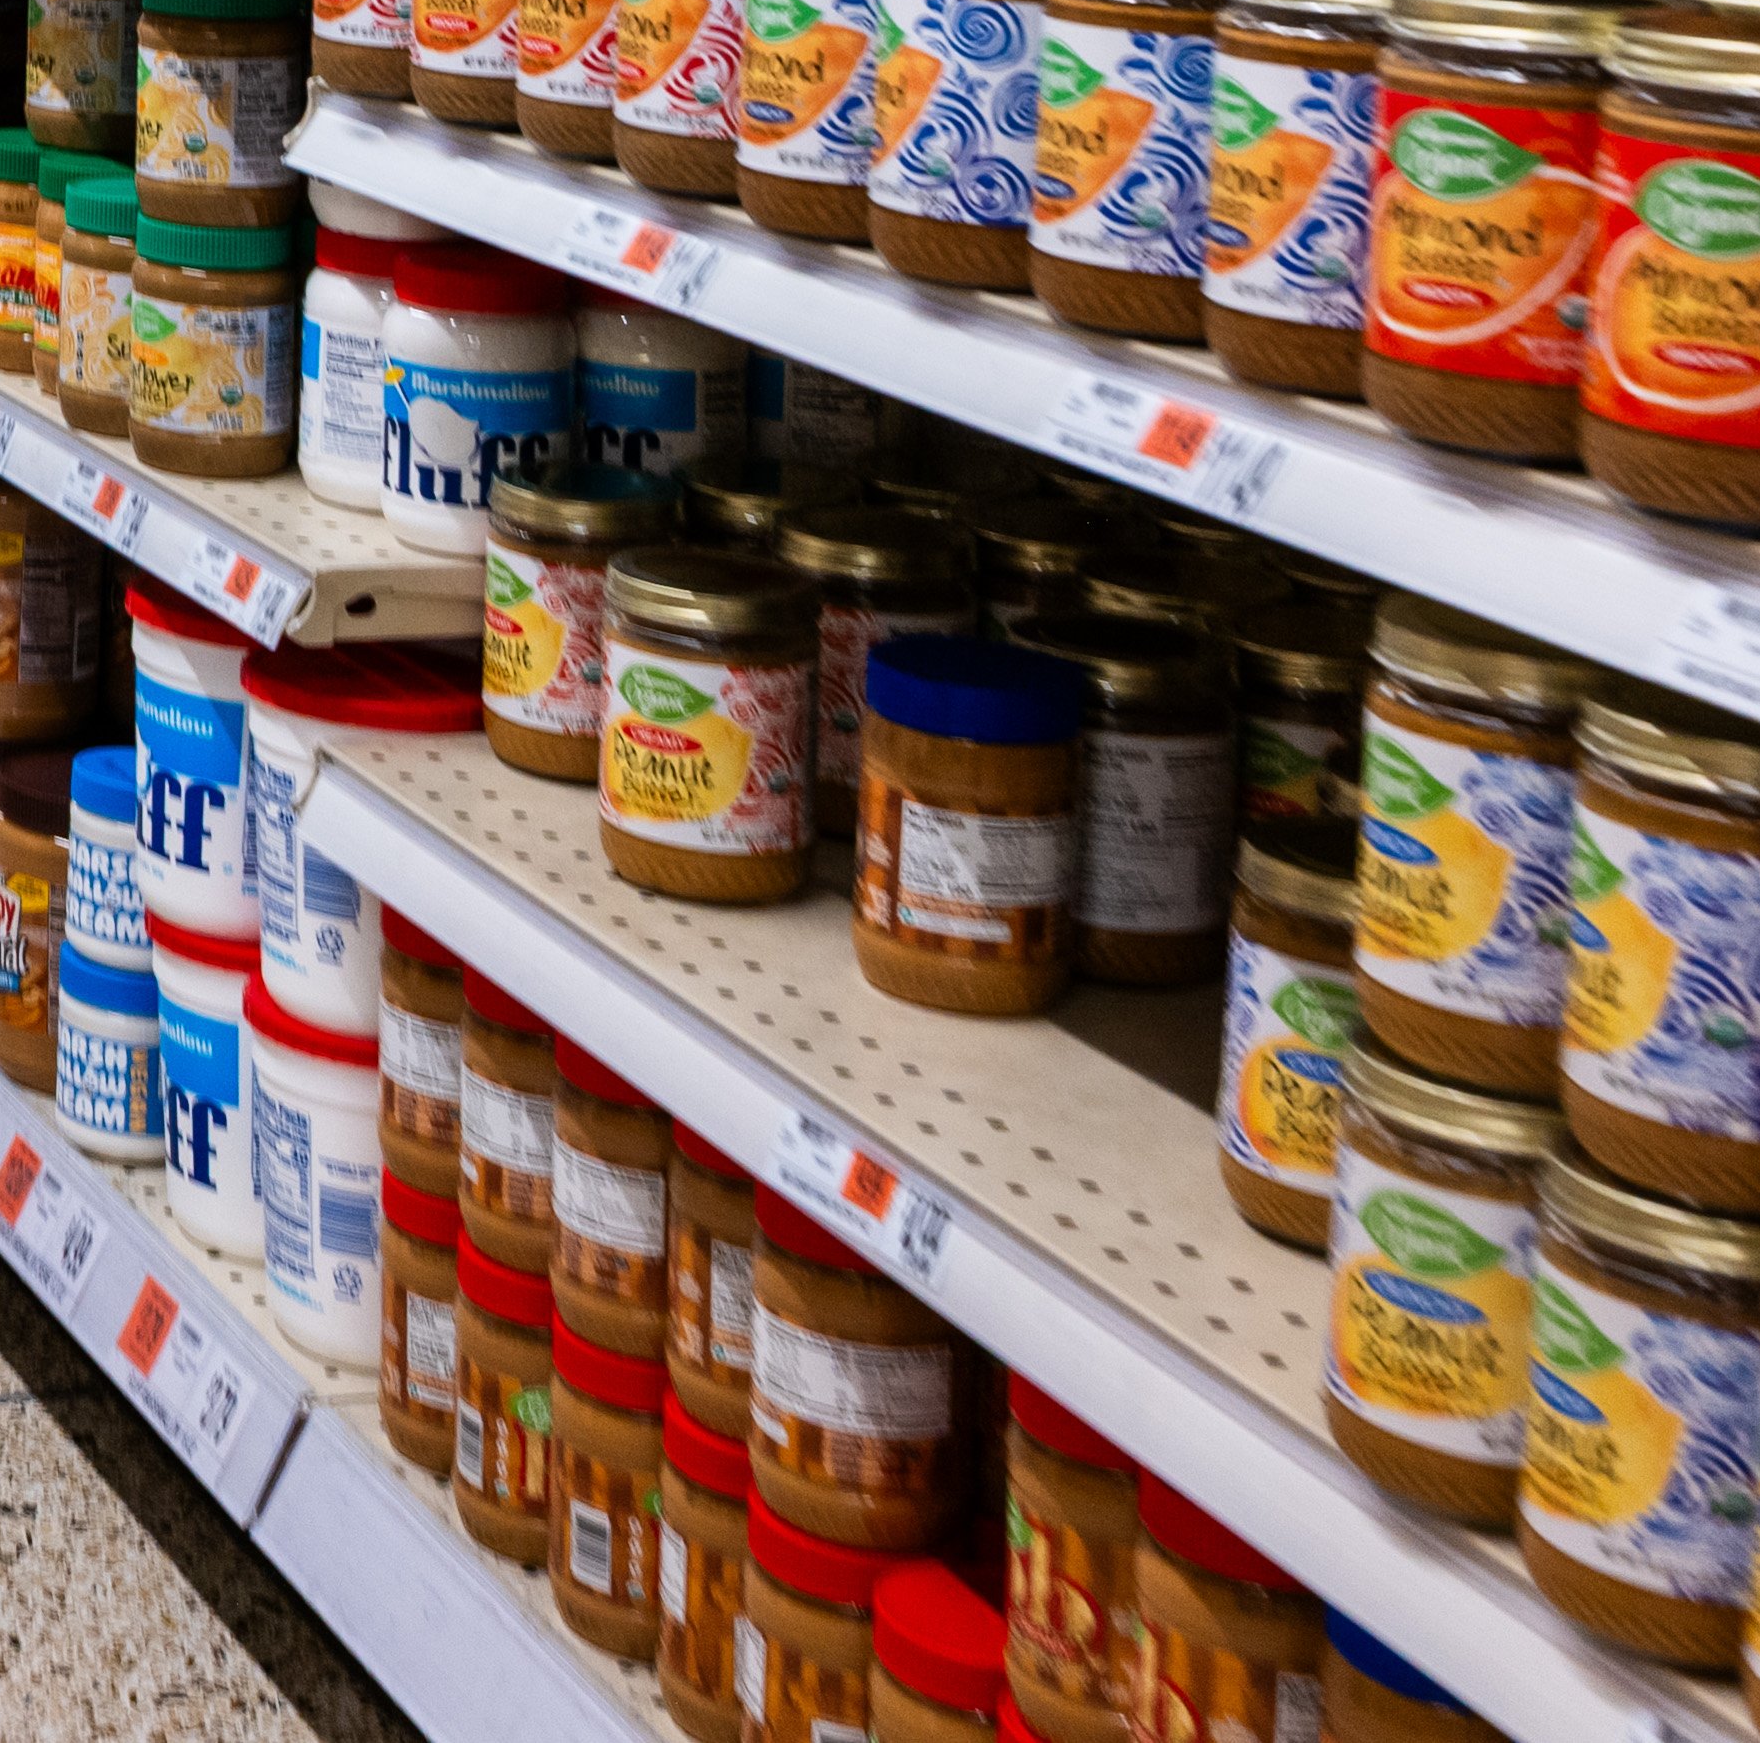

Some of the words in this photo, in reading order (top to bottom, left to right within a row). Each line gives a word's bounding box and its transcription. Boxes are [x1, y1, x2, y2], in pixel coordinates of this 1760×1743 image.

[410, 370, 551, 403] Marshmallow
[483, 635, 532, 672] eanut
[67, 907, 149, 947] REAM
[58, 1023, 129, 1073] ARSH
